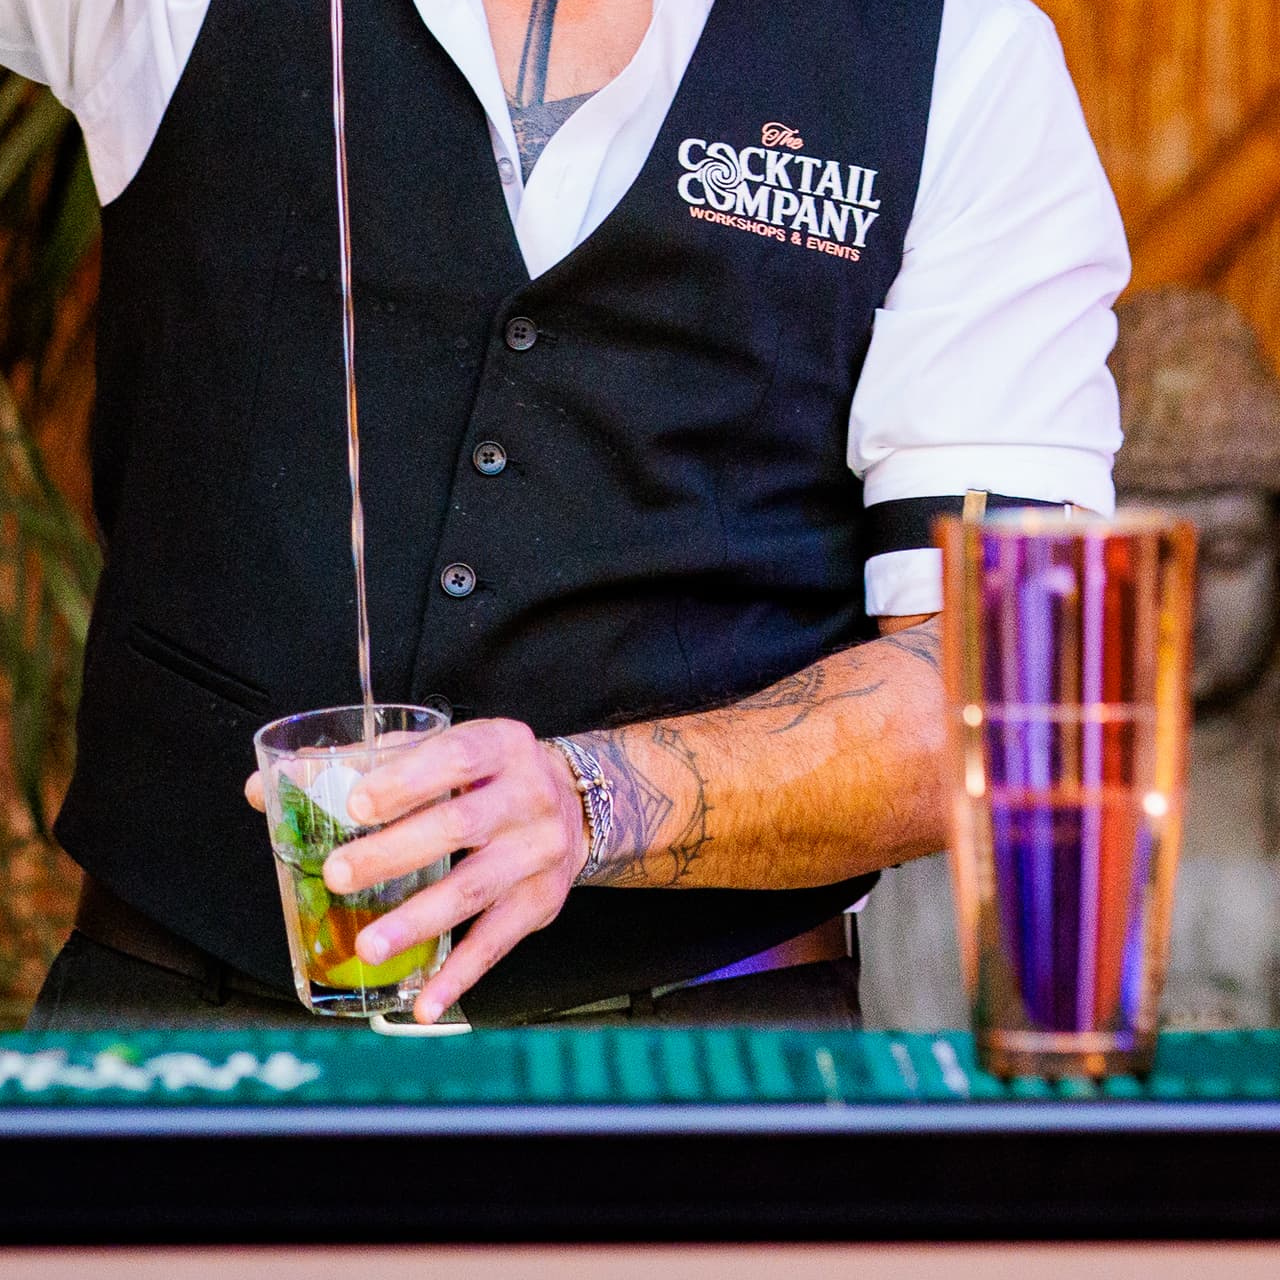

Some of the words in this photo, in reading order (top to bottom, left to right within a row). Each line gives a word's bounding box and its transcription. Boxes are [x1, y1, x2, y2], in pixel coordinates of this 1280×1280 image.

[761, 122, 804, 150] The
[677, 138, 882, 210] COCKTAIL
[677, 168, 880, 248] COMPANY
[689, 206, 786, 242] WORKSHOPS
[791, 232, 802, 246] &
[806, 236, 861, 262] EVENTS
